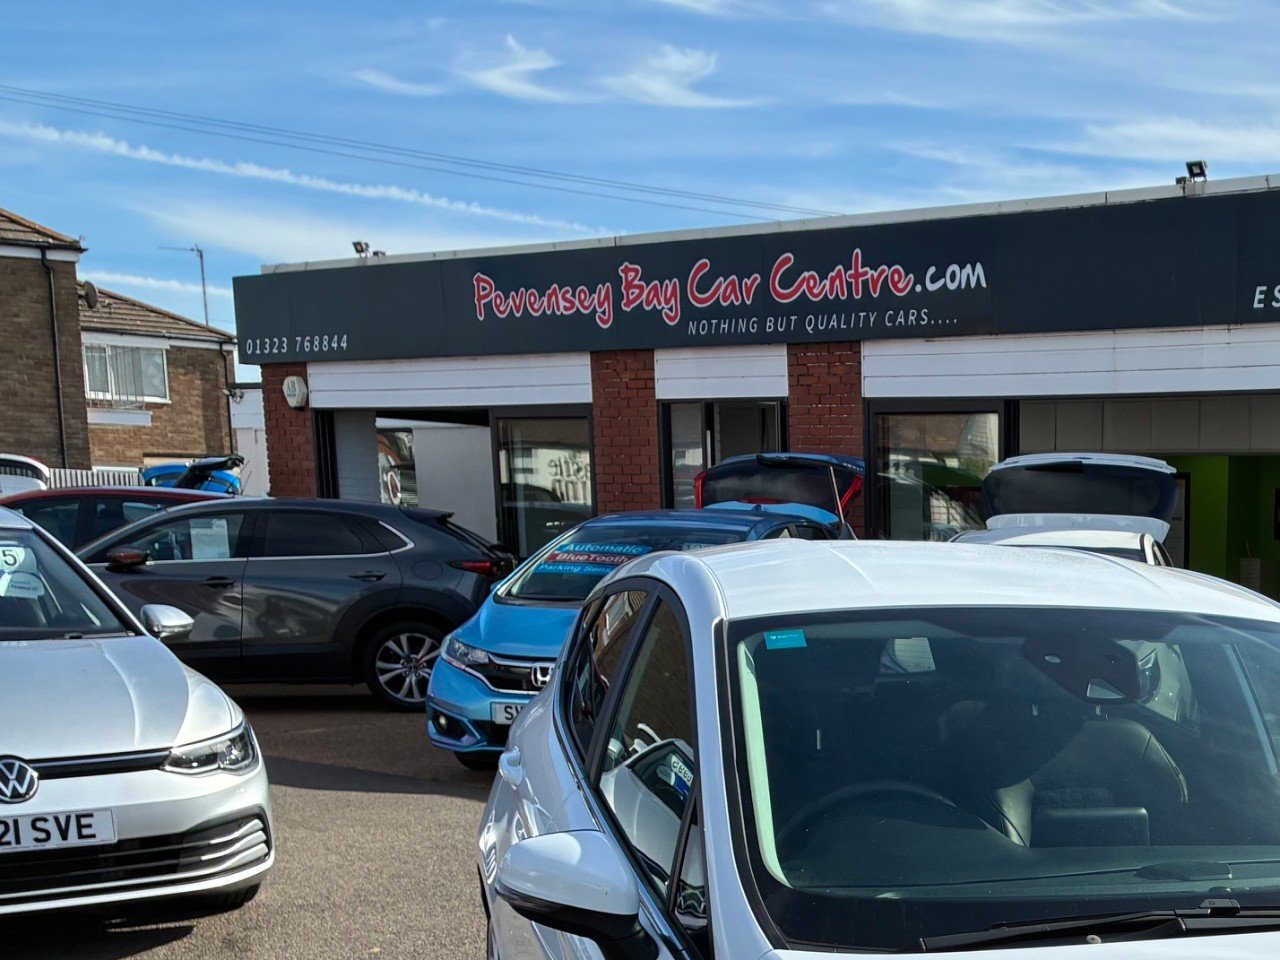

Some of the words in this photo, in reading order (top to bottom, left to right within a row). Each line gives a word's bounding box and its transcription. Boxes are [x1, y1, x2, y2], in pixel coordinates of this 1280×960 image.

[472, 272, 613, 328] Pevensey
[619, 261, 681, 326] Bay
[687, 258, 761, 307] Car
[688, 317, 758, 336] NOTHING
[766, 315, 797, 333] BUT
[805, 311, 877, 334] QUALITY
[246, 337, 288, 355] 01323
[295, 334, 348, 352] 768844
[562, 543, 642, 554] Automatic
[540, 563, 581, 573] Parking
[31, 812, 97, 844] SVE
